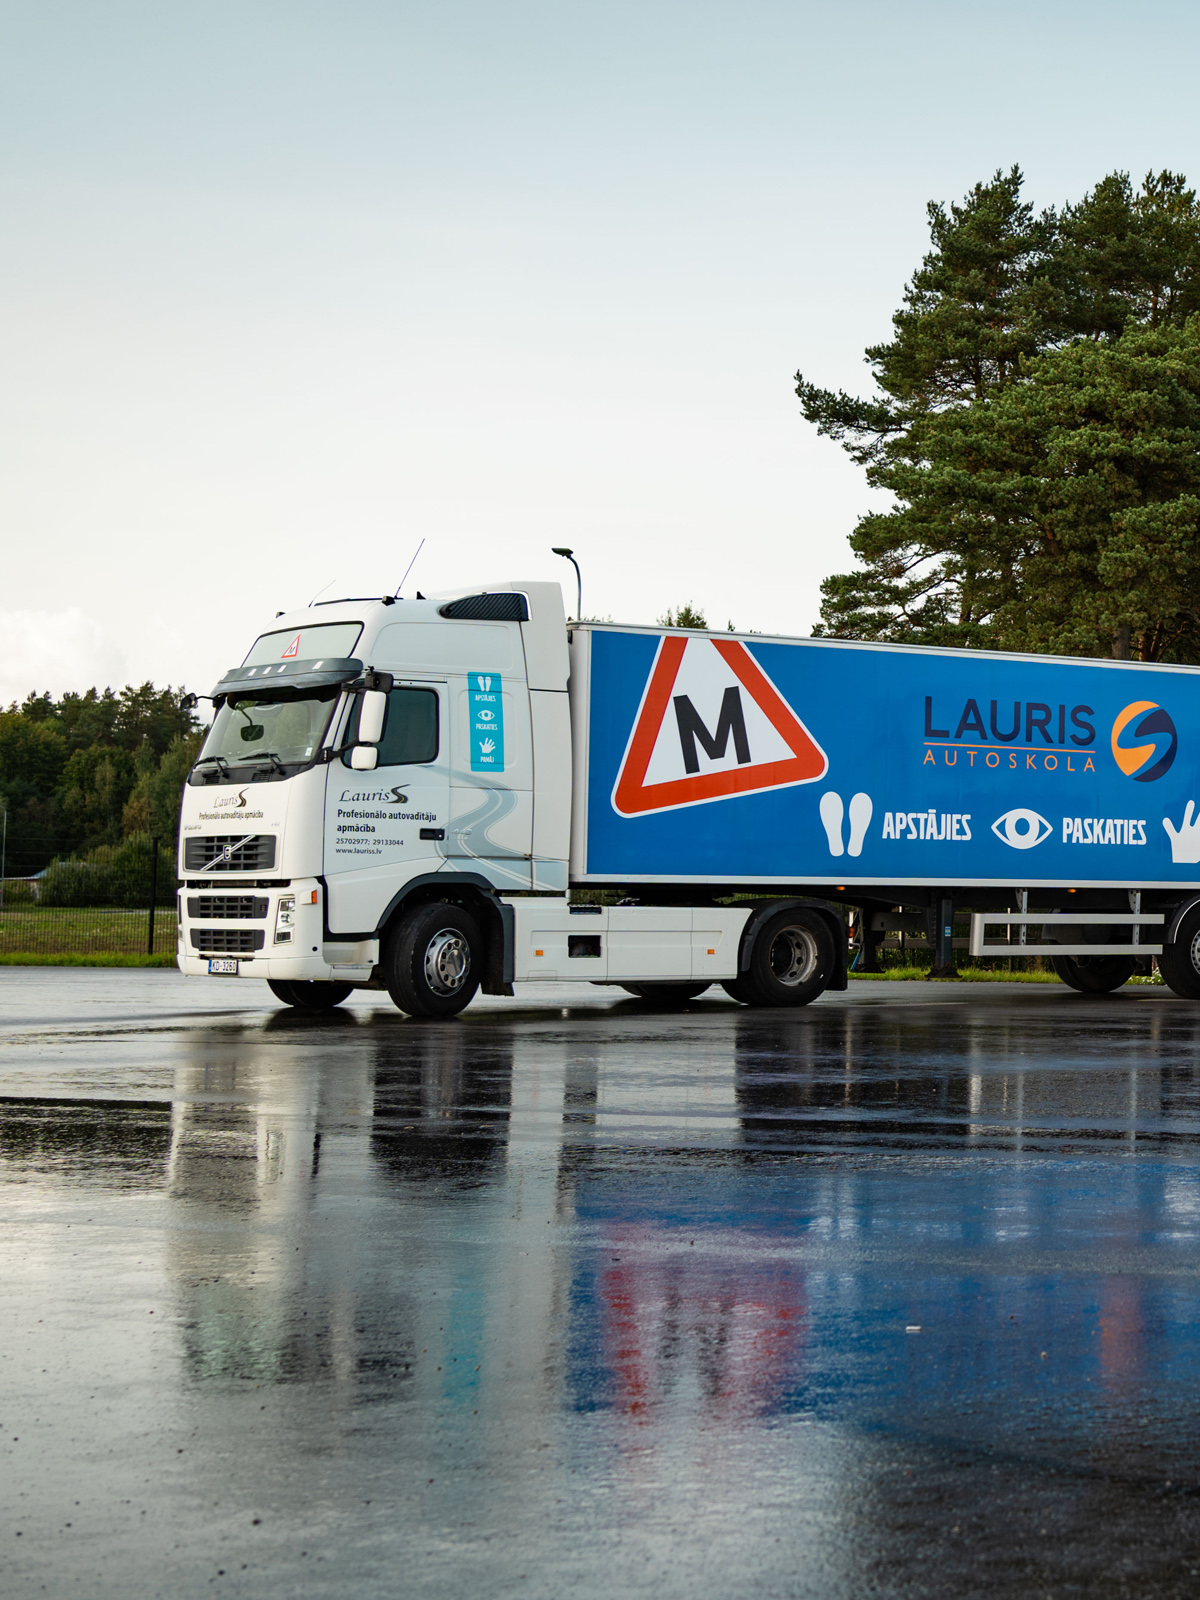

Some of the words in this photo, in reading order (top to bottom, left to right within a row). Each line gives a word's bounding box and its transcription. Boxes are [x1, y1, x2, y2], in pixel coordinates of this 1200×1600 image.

[673, 686, 751, 774] M
[923, 695, 1096, 746] LAURIS
[923, 749, 1096, 772] AUTOSKOLA
[336, 824, 376, 834] apmācība
[337, 809, 387, 819] Profesionālo
[388, 812, 437, 823] autovadītāju
[882, 809, 972, 841] APSTĀJIES
[1062, 817, 1147, 846] PASKATIES
